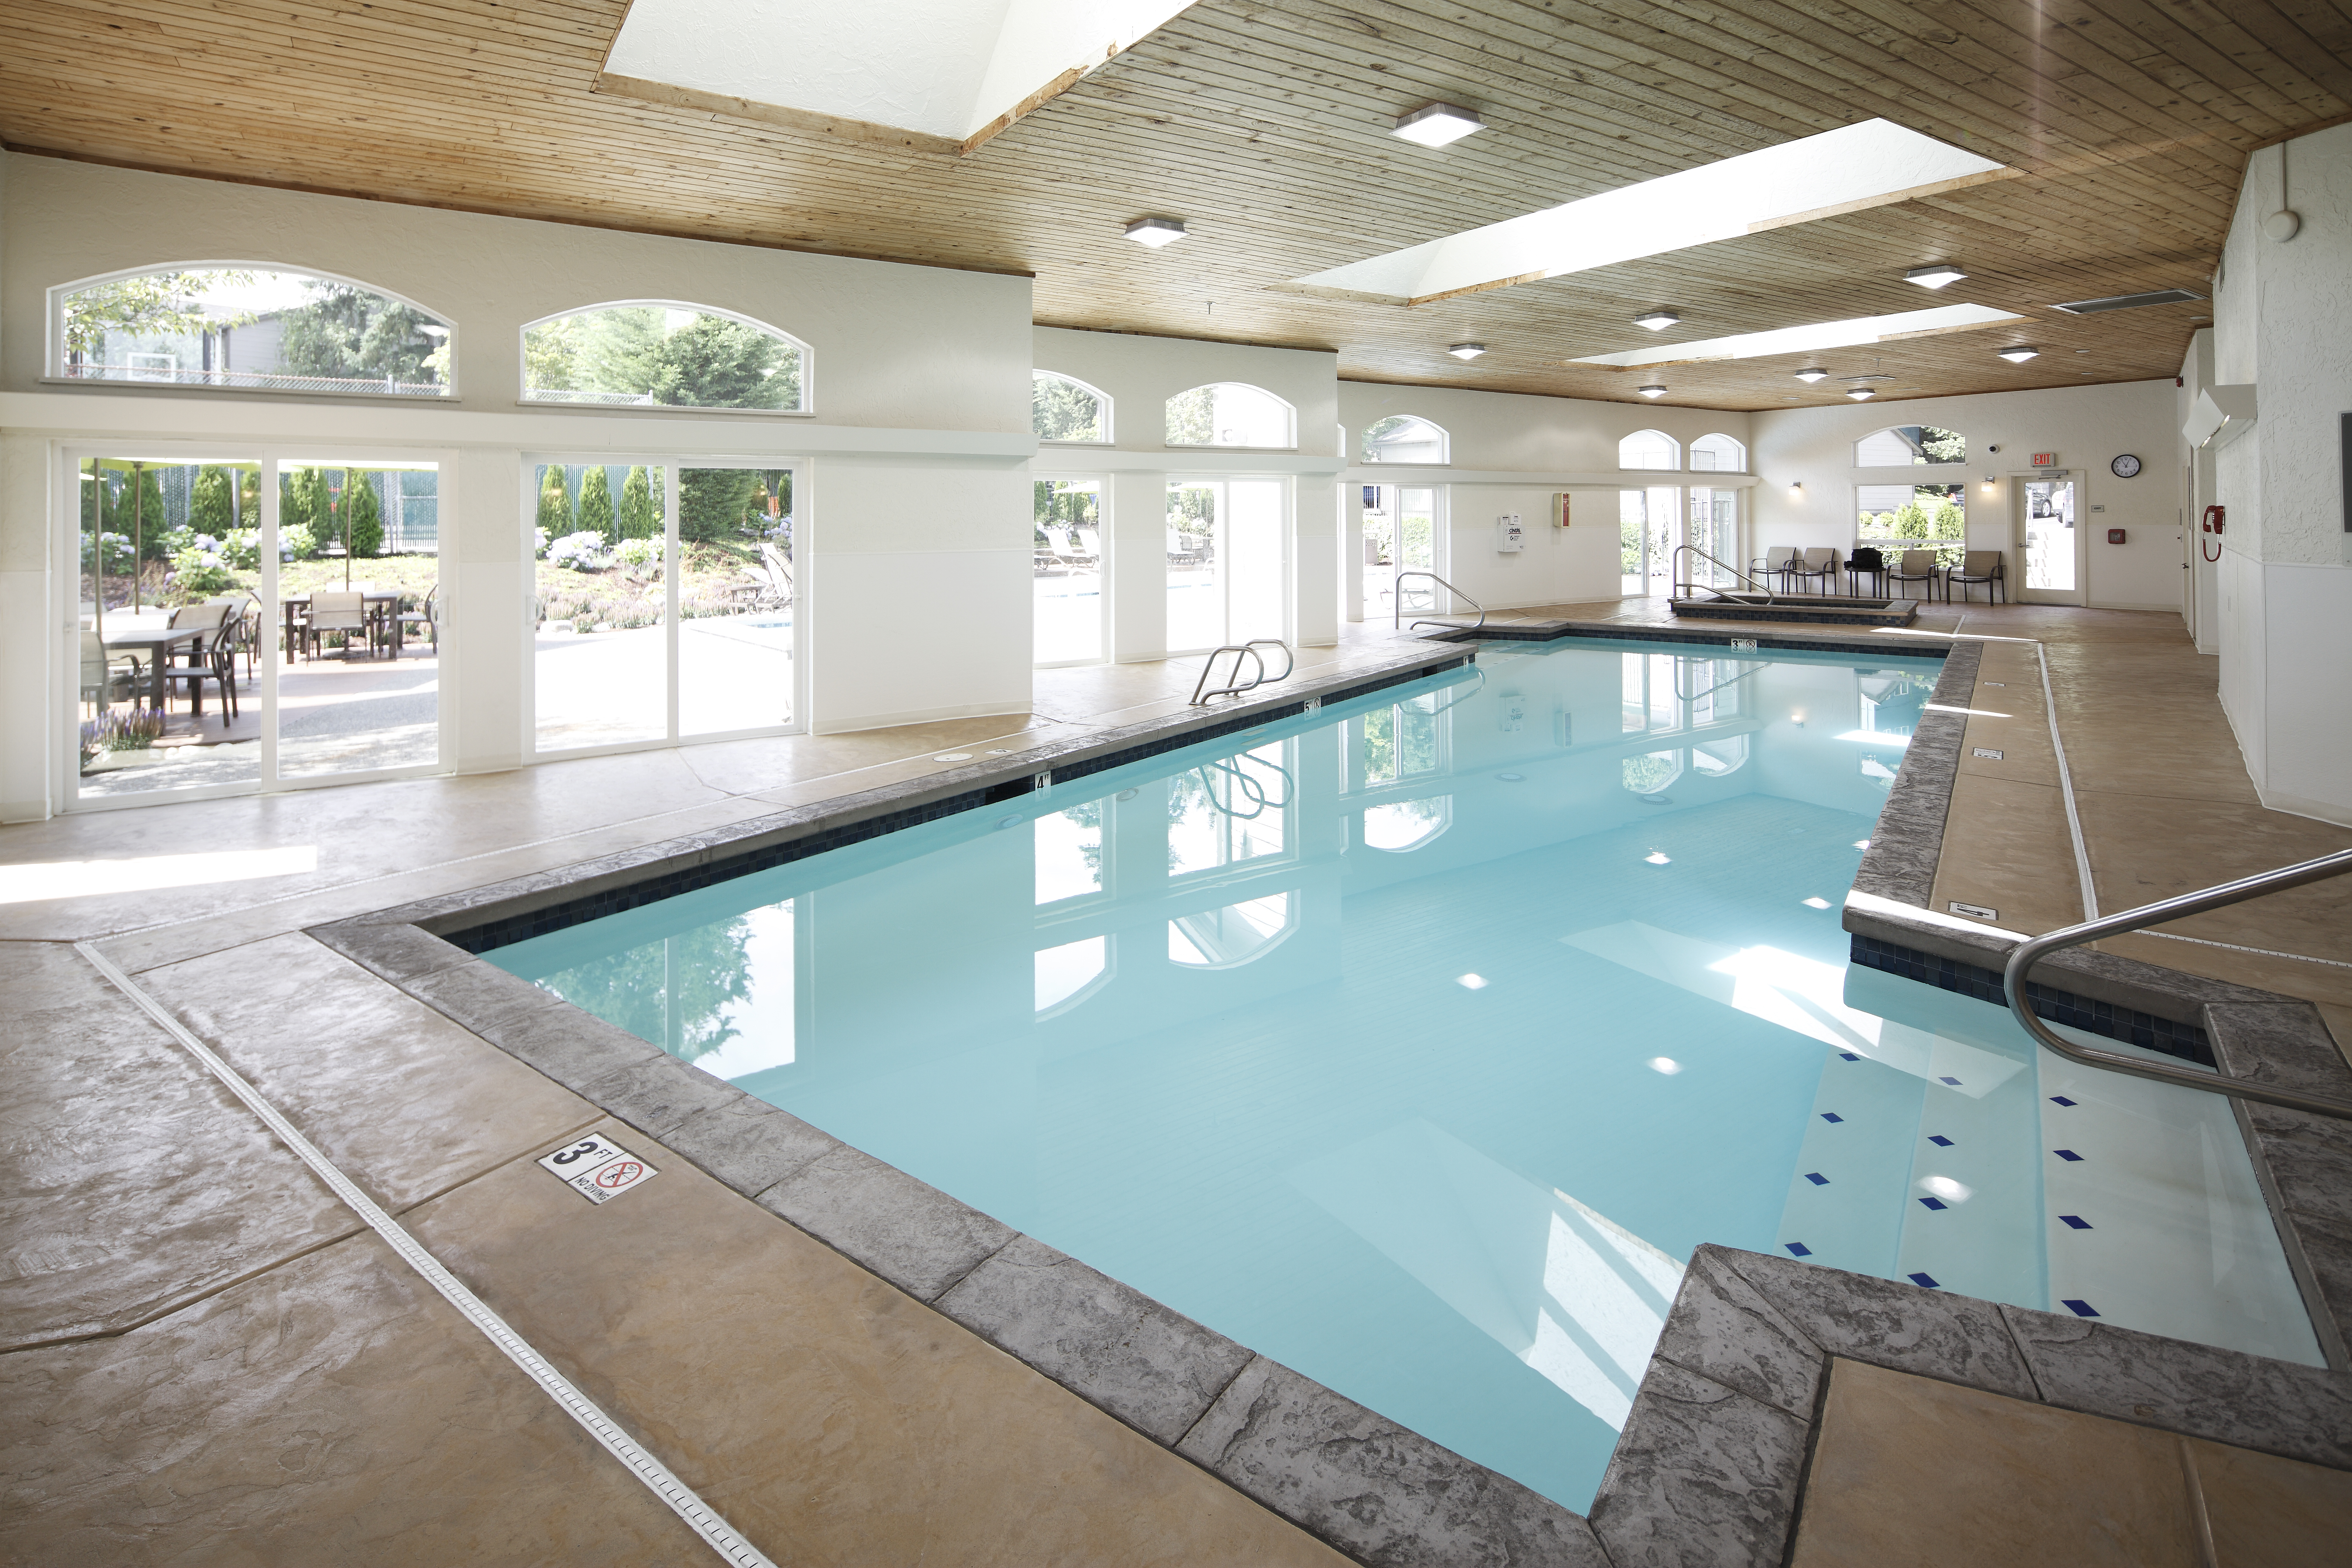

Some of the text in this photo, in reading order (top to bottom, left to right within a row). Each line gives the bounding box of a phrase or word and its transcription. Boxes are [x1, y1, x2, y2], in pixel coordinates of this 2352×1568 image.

[2034, 454, 2050, 464] EXIT
[1305, 702, 1309, 711] 5
[1037, 776, 1044, 789] 4
[1957, 908, 1990, 917] 4
[553, 1141, 613, 1164] 3 FT
[575, 1177, 610, 1200] NO DIVING
